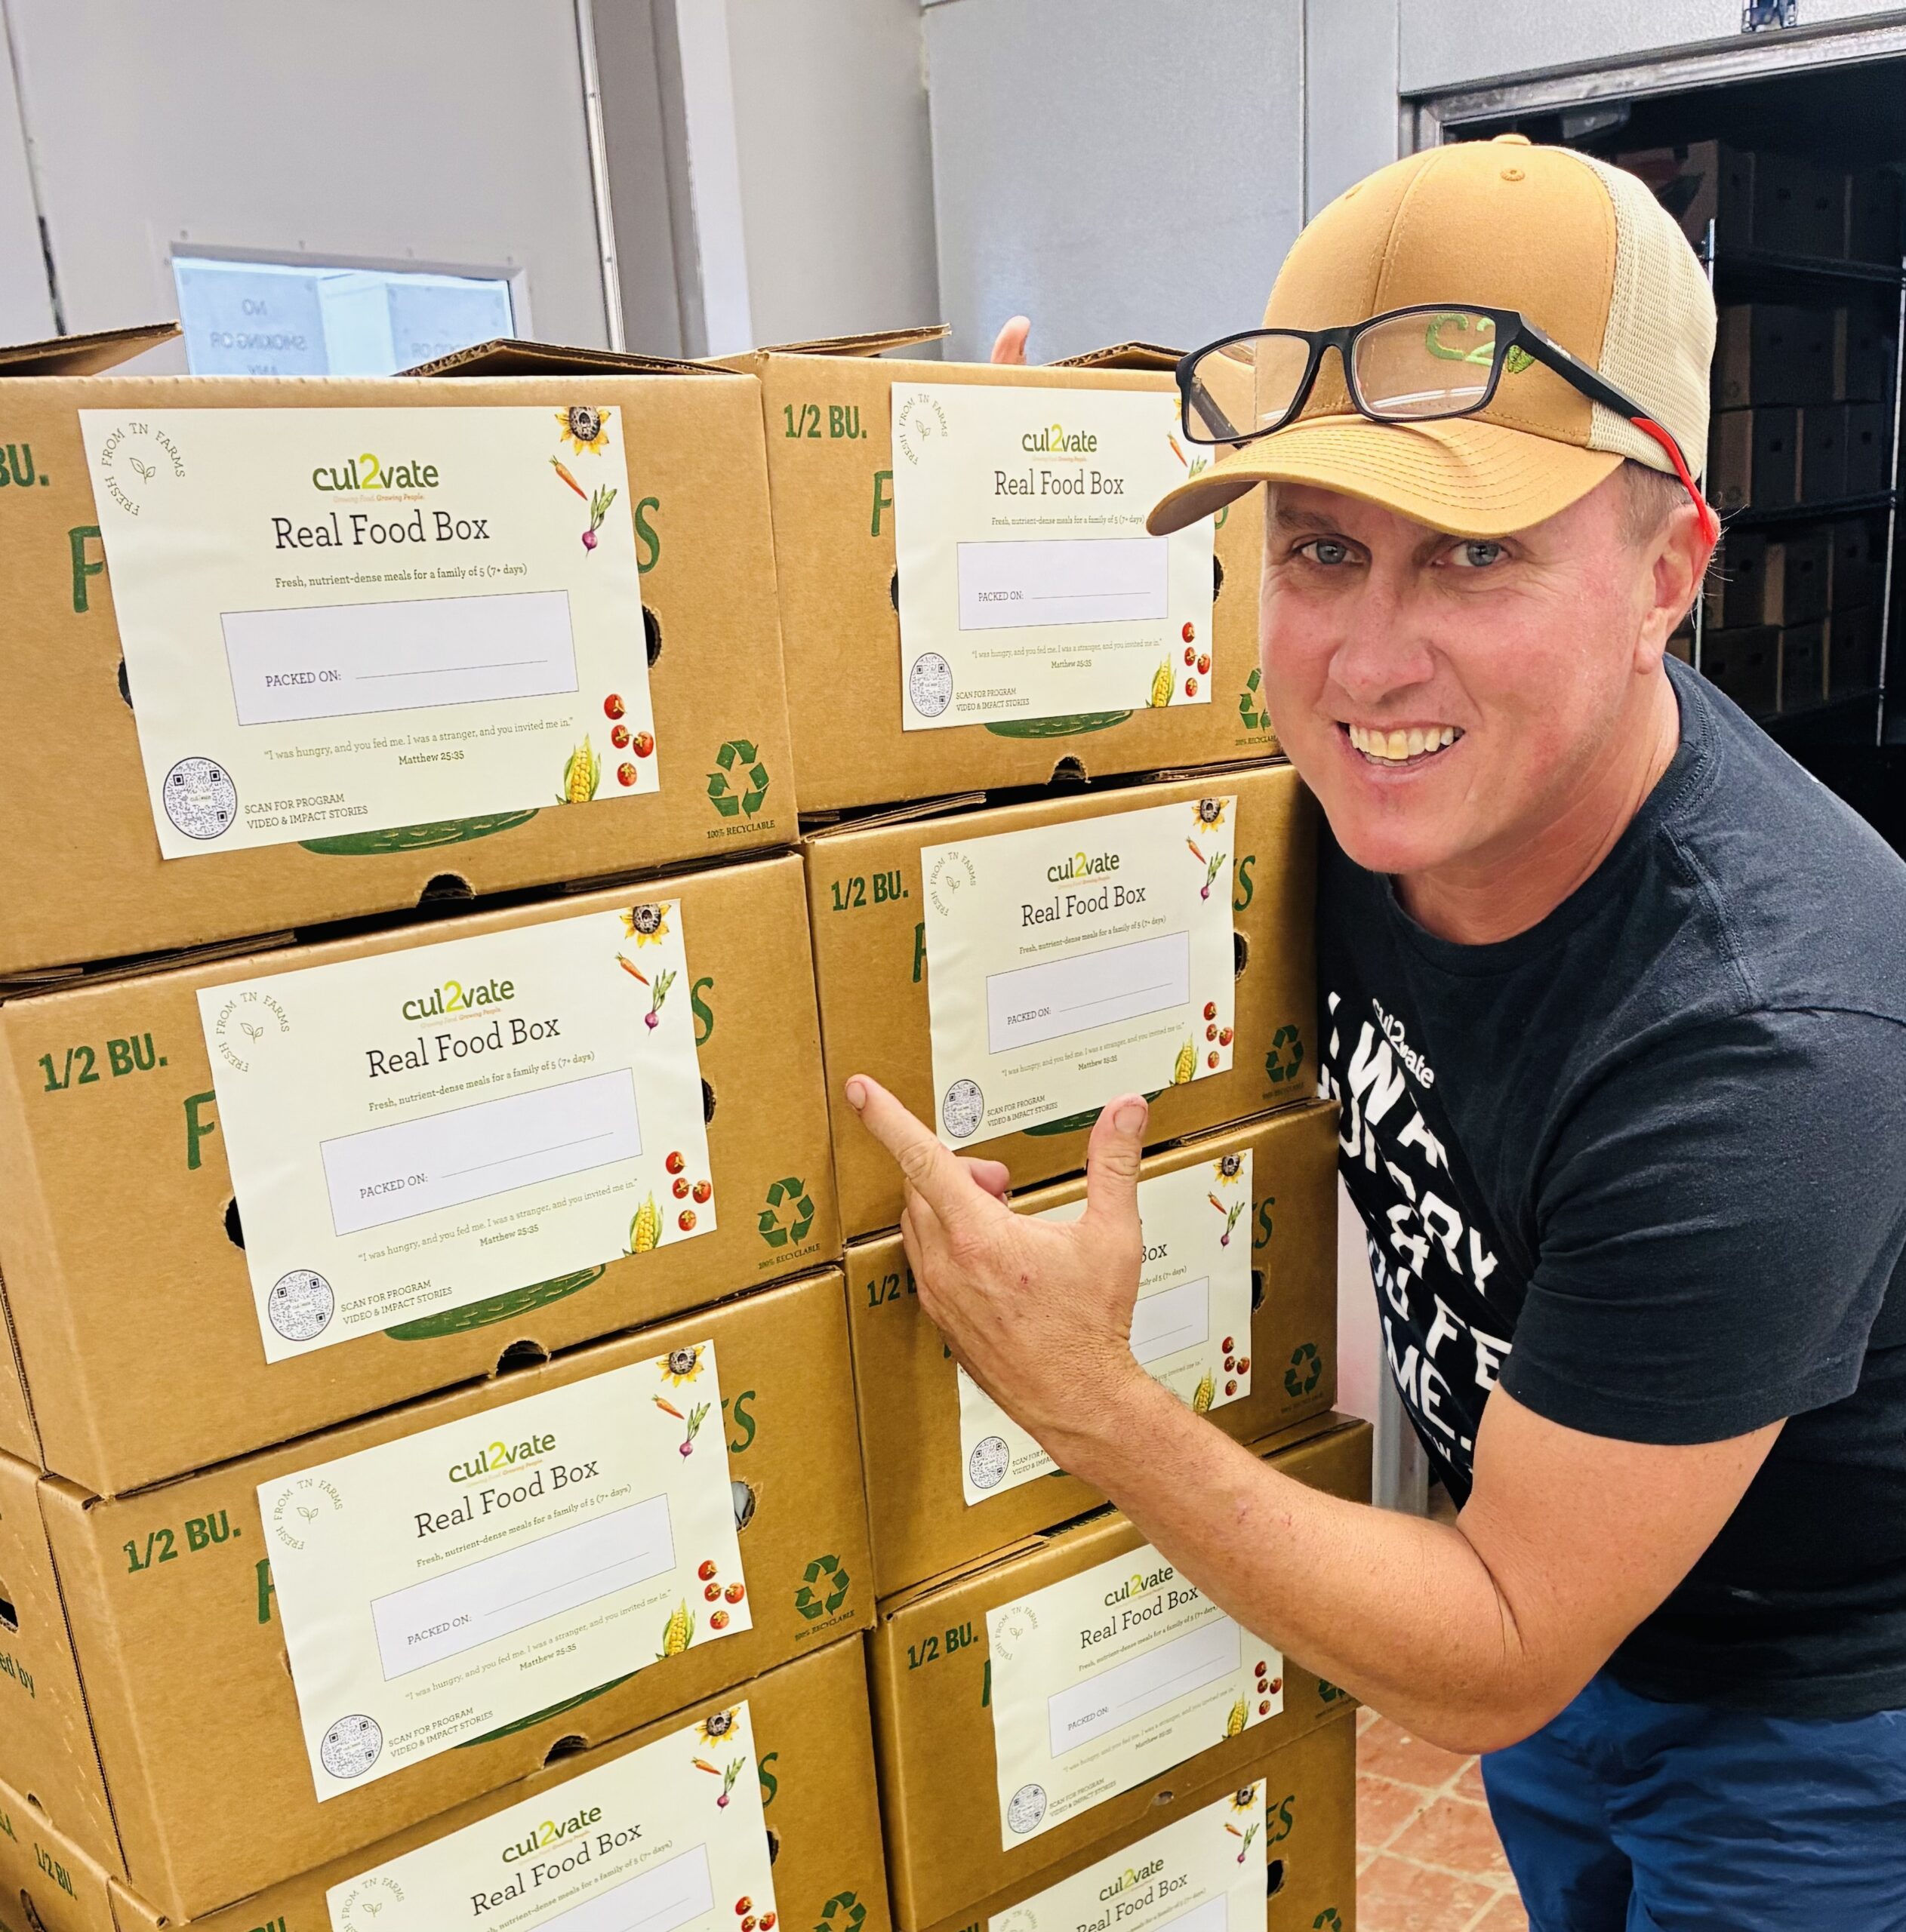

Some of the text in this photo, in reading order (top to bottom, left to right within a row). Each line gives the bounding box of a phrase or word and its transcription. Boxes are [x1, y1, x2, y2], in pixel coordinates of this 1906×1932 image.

[784, 404, 867, 439] 1/2 BU.
[1021, 423, 1098, 453] cul2vate
[100, 422, 185, 515] FRESH FROM TN FARMS
[312, 452, 439, 491] cul2vate
[993, 467, 1124, 495] Real Food Box
[270, 508, 490, 549] Real Food Box
[274, 575, 306, 588] Fresh,
[308, 572, 382, 586] nutrient-dense
[383, 569, 412, 582] meals
[413, 568, 428, 580] for
[436, 566, 466, 580] family
[467, 565, 478, 576] of
[479, 568, 485, 577] 5
[502, 562, 527, 576] days)
[978, 590, 1024, 601] PACKED ON:
[264, 669, 341, 688] PACKED ON:
[275, 750, 294, 758] was
[295, 746, 333, 758] hungry,
[334, 740, 352, 752] and
[353, 742, 371, 752] you
[372, 737, 387, 748] fed
[389, 738, 405, 746] me.
[406, 734, 411, 744] I
[412, 735, 430, 743] was
[439, 730, 478, 741] stranger,
[479, 724, 495, 736] and
[497, 726, 513, 736] you
[514, 719, 543, 732] invited
[545, 721, 558, 729] me
[398, 749, 464, 765] Matthew 25:35
[244, 792, 345, 814] SCAN FOR PROGRAM
[246, 804, 368, 829] VIDEO & IMPACT STORIES
[727, 820, 775, 835] RECYCLABLE
[1046, 851, 1120, 882] cul2vate
[831, 870, 909, 911] 1/2 BU.
[1021, 884, 1146, 928] Real Food Box
[401, 978, 516, 1021] cul2vate
[1007, 1007, 1051, 1025] PACKED ON:
[215, 991, 289, 1072] FRESH FROM TN FARMS
[365, 1017, 562, 1078] Real Food Box
[38, 1032, 168, 1091] 1/2 BU.
[368, 1097, 396, 1112] Fresh,
[398, 1084, 464, 1105] nutrient-dense
[465, 1075, 491, 1089] meals
[492, 1072, 505, 1082] for
[513, 1063, 540, 1077] family
[541, 1060, 550, 1070] of
[551, 1060, 557, 1069] 5
[572, 1050, 595, 1063] days)
[359, 1173, 427, 1198] PACKED ON:
[478, 1223, 539, 1247] Matthew 25:35
[776, 1243, 821, 1263] RECYCLABLE
[340, 1279, 430, 1312] SCAN FOR PROGRAM
[342, 1286, 451, 1324] VIDEO & IMPACT STORIES
[867, 1273, 901, 1307] 1/2
[448, 1433, 556, 1483] cul2vate
[273, 1478, 343, 1550] FRESH FROM TN FARMS
[413, 1460, 600, 1538] Real Food Box
[122, 1510, 241, 1574] 1/2 BU.
[1104, 1566, 1173, 1607] cul2vate
[407, 1614, 472, 1645] PACKED ON:
[1079, 1615, 1117, 1650] Real
[1121, 1595, 1163, 1631] Food
[1167, 1586, 1199, 1611] Box
[907, 1621, 978, 1671] 1/2 BU.
[1067, 1706, 1109, 1730] PACKED ON:
[501, 1806, 602, 1863] cul2vate
[470, 1823, 642, 1916] Real Food Box
[1098, 1859, 1164, 1901] cul2vate
[1115, 1885, 1154, 1921] Food
[1158, 1873, 1188, 1899] Box
